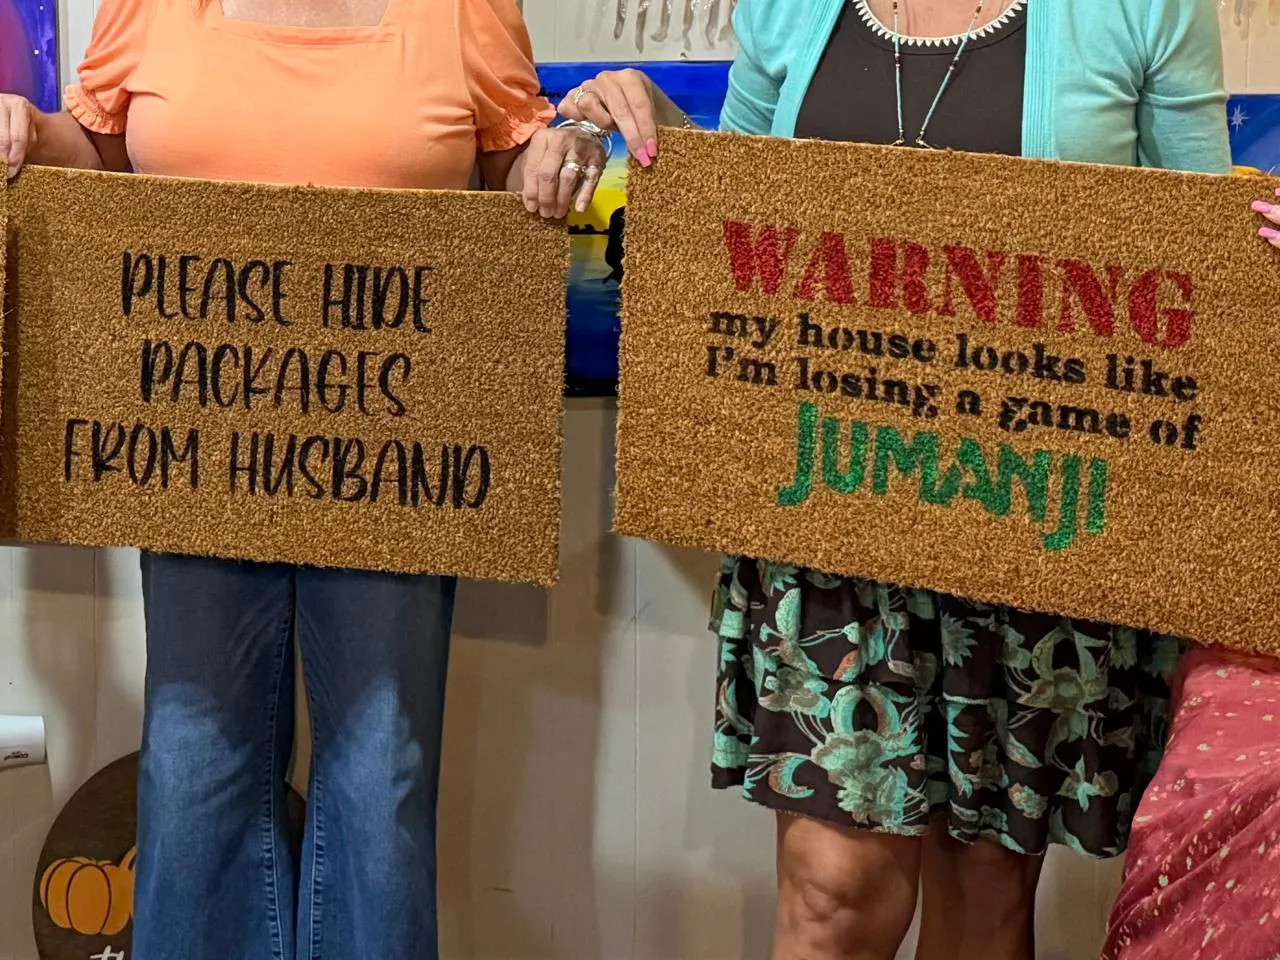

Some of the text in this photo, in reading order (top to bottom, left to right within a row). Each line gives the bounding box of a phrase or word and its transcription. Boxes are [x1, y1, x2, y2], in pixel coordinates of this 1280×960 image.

[121, 251, 438, 334] PLEASE HIDE
[721, 220, 1196, 350] WARNING
[140, 340, 412, 418] PACKAGES
[706, 345, 1202, 451] I'm losing a game of
[707, 309, 1200, 402] my house looks like
[64, 418, 493, 511] FROM HUSBAND
[776, 401, 1110, 552] JUMANJI
